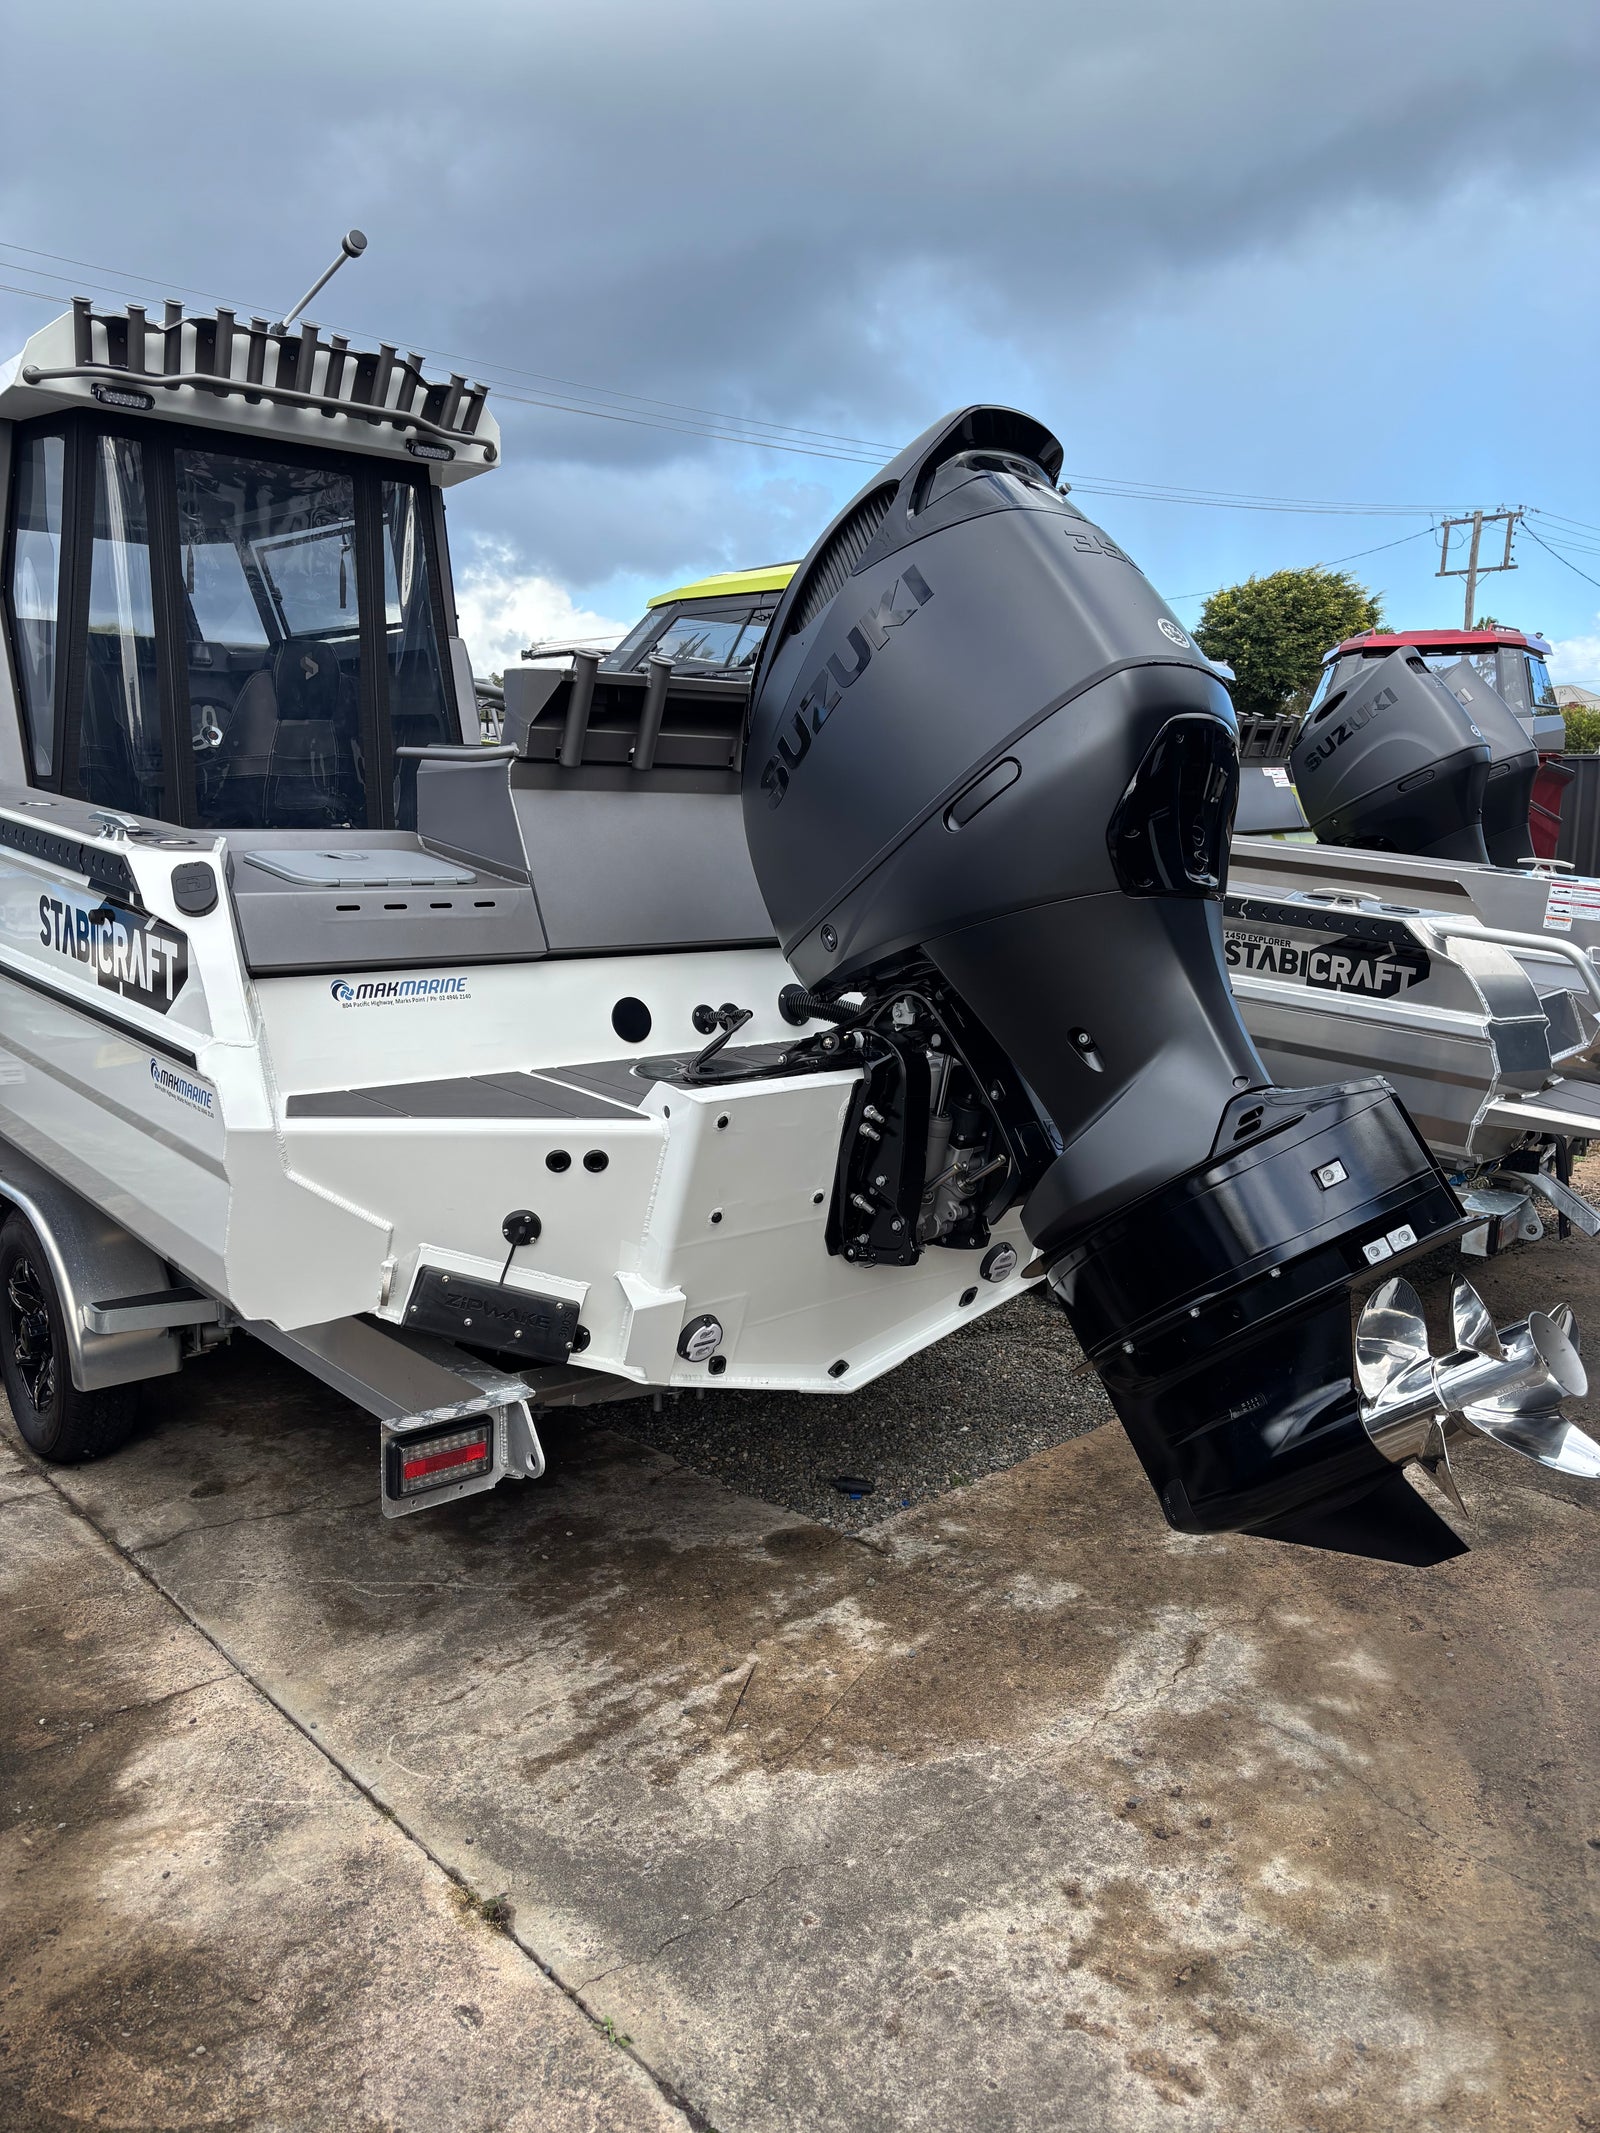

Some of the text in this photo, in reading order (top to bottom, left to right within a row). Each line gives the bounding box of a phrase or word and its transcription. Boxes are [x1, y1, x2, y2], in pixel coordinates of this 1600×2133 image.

[760, 564, 934, 810] SUZUKI
[1304, 687, 1399, 773] SUZUKI
[39, 894, 178, 1001] STABICRAFT
[1224, 931, 1292, 948] 1450 EXPLORER
[1224, 939, 1417, 992] STABICRAFT
[352, 1000, 370, 1008] Pacific
